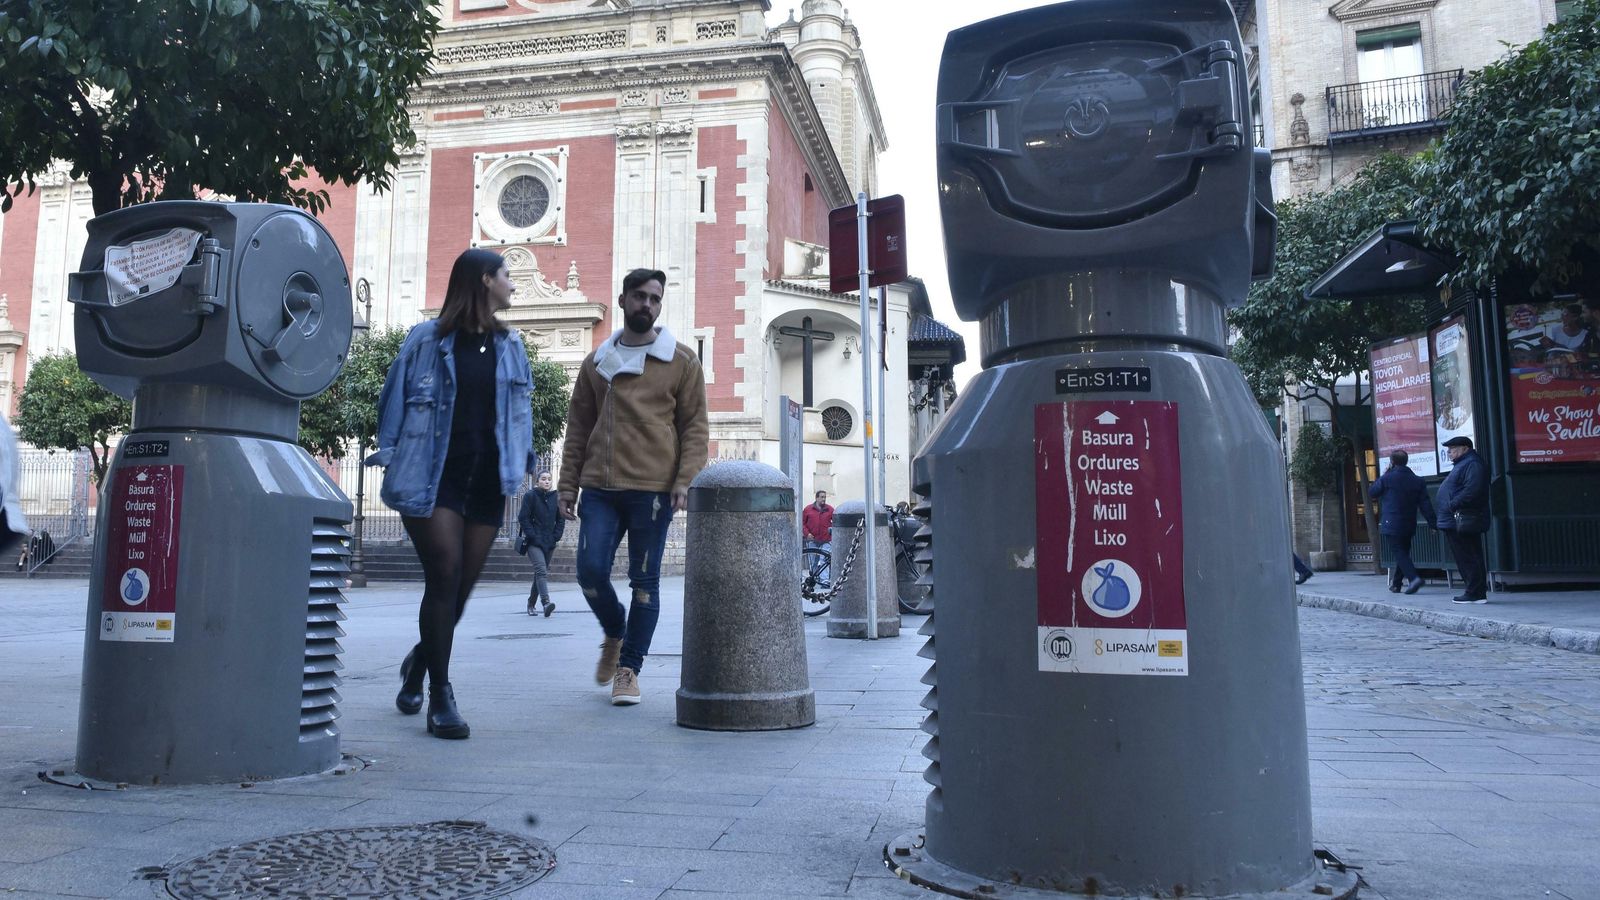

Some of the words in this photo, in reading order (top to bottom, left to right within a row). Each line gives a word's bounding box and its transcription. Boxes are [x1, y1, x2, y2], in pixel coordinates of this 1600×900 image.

[1373, 356, 1392, 367] CENTRO
[1393, 351, 1413, 363] OFICIAL
[1374, 364, 1404, 380] TOYOTA
[1375, 372, 1431, 393] HISPALJARAFE
[1528, 408, 1550, 424] We
[1554, 406, 1594, 421] Show
[1082, 430, 1134, 446] Basura
[1546, 418, 1600, 442] Seville
[1077, 453, 1139, 471] Ordures
[128, 484, 154, 495] Basura
[1085, 479, 1133, 496] Waste
[125, 500, 156, 511] Ordures
[1093, 503, 1127, 521] Müll
[127, 516, 151, 527] Waste
[129, 532, 146, 544] Müll
[1094, 529, 1127, 546] Lixo
[128, 548, 145, 559] Lixo
[1106, 643, 1155, 653] LIPASAM
